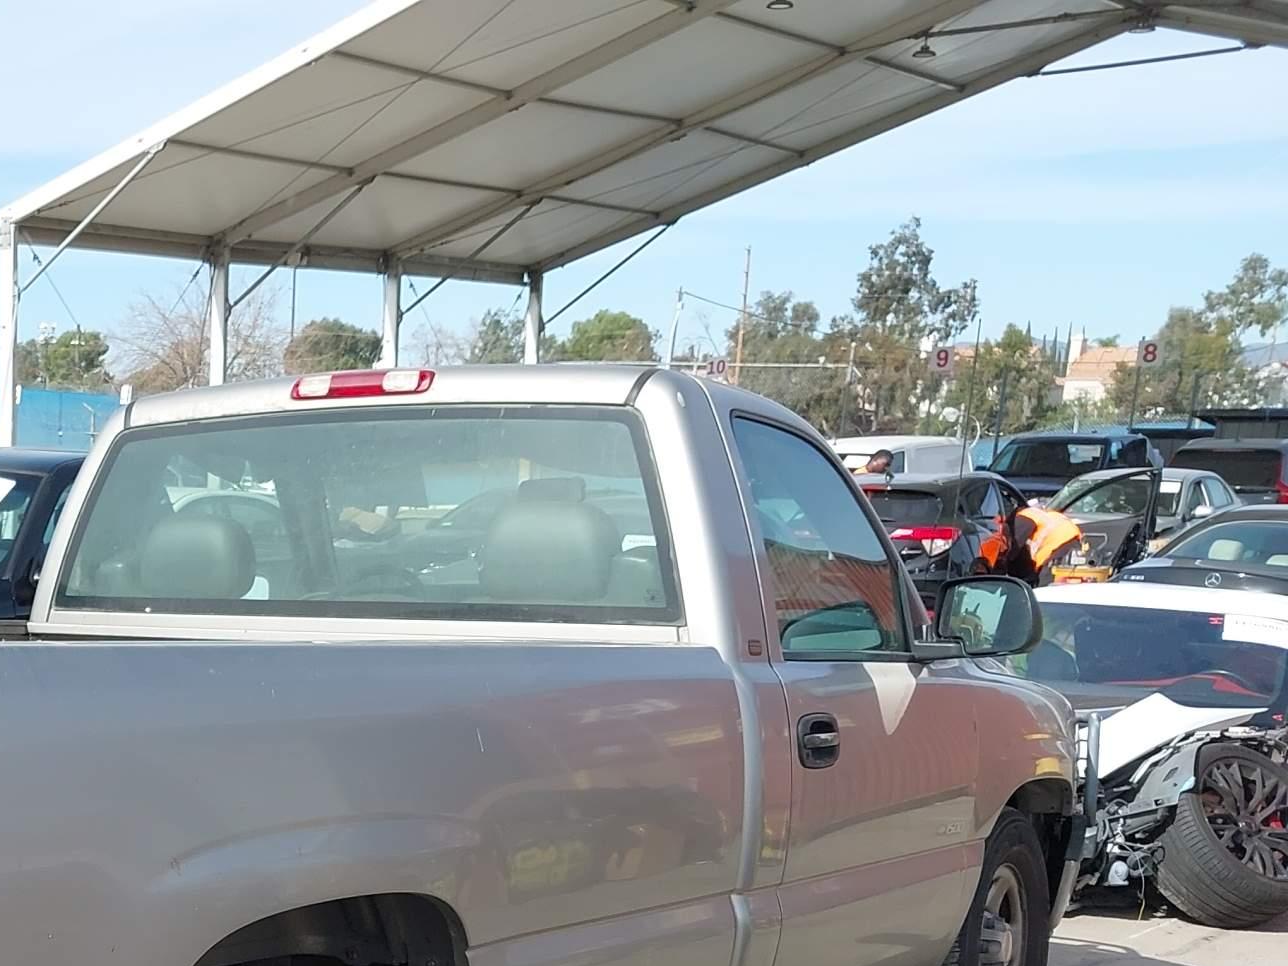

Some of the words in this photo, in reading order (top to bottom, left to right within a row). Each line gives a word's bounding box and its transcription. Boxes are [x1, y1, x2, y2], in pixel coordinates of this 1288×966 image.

[936, 349, 949, 367] 9
[1143, 343, 1157, 362] 8
[707, 359, 726, 375] 10
